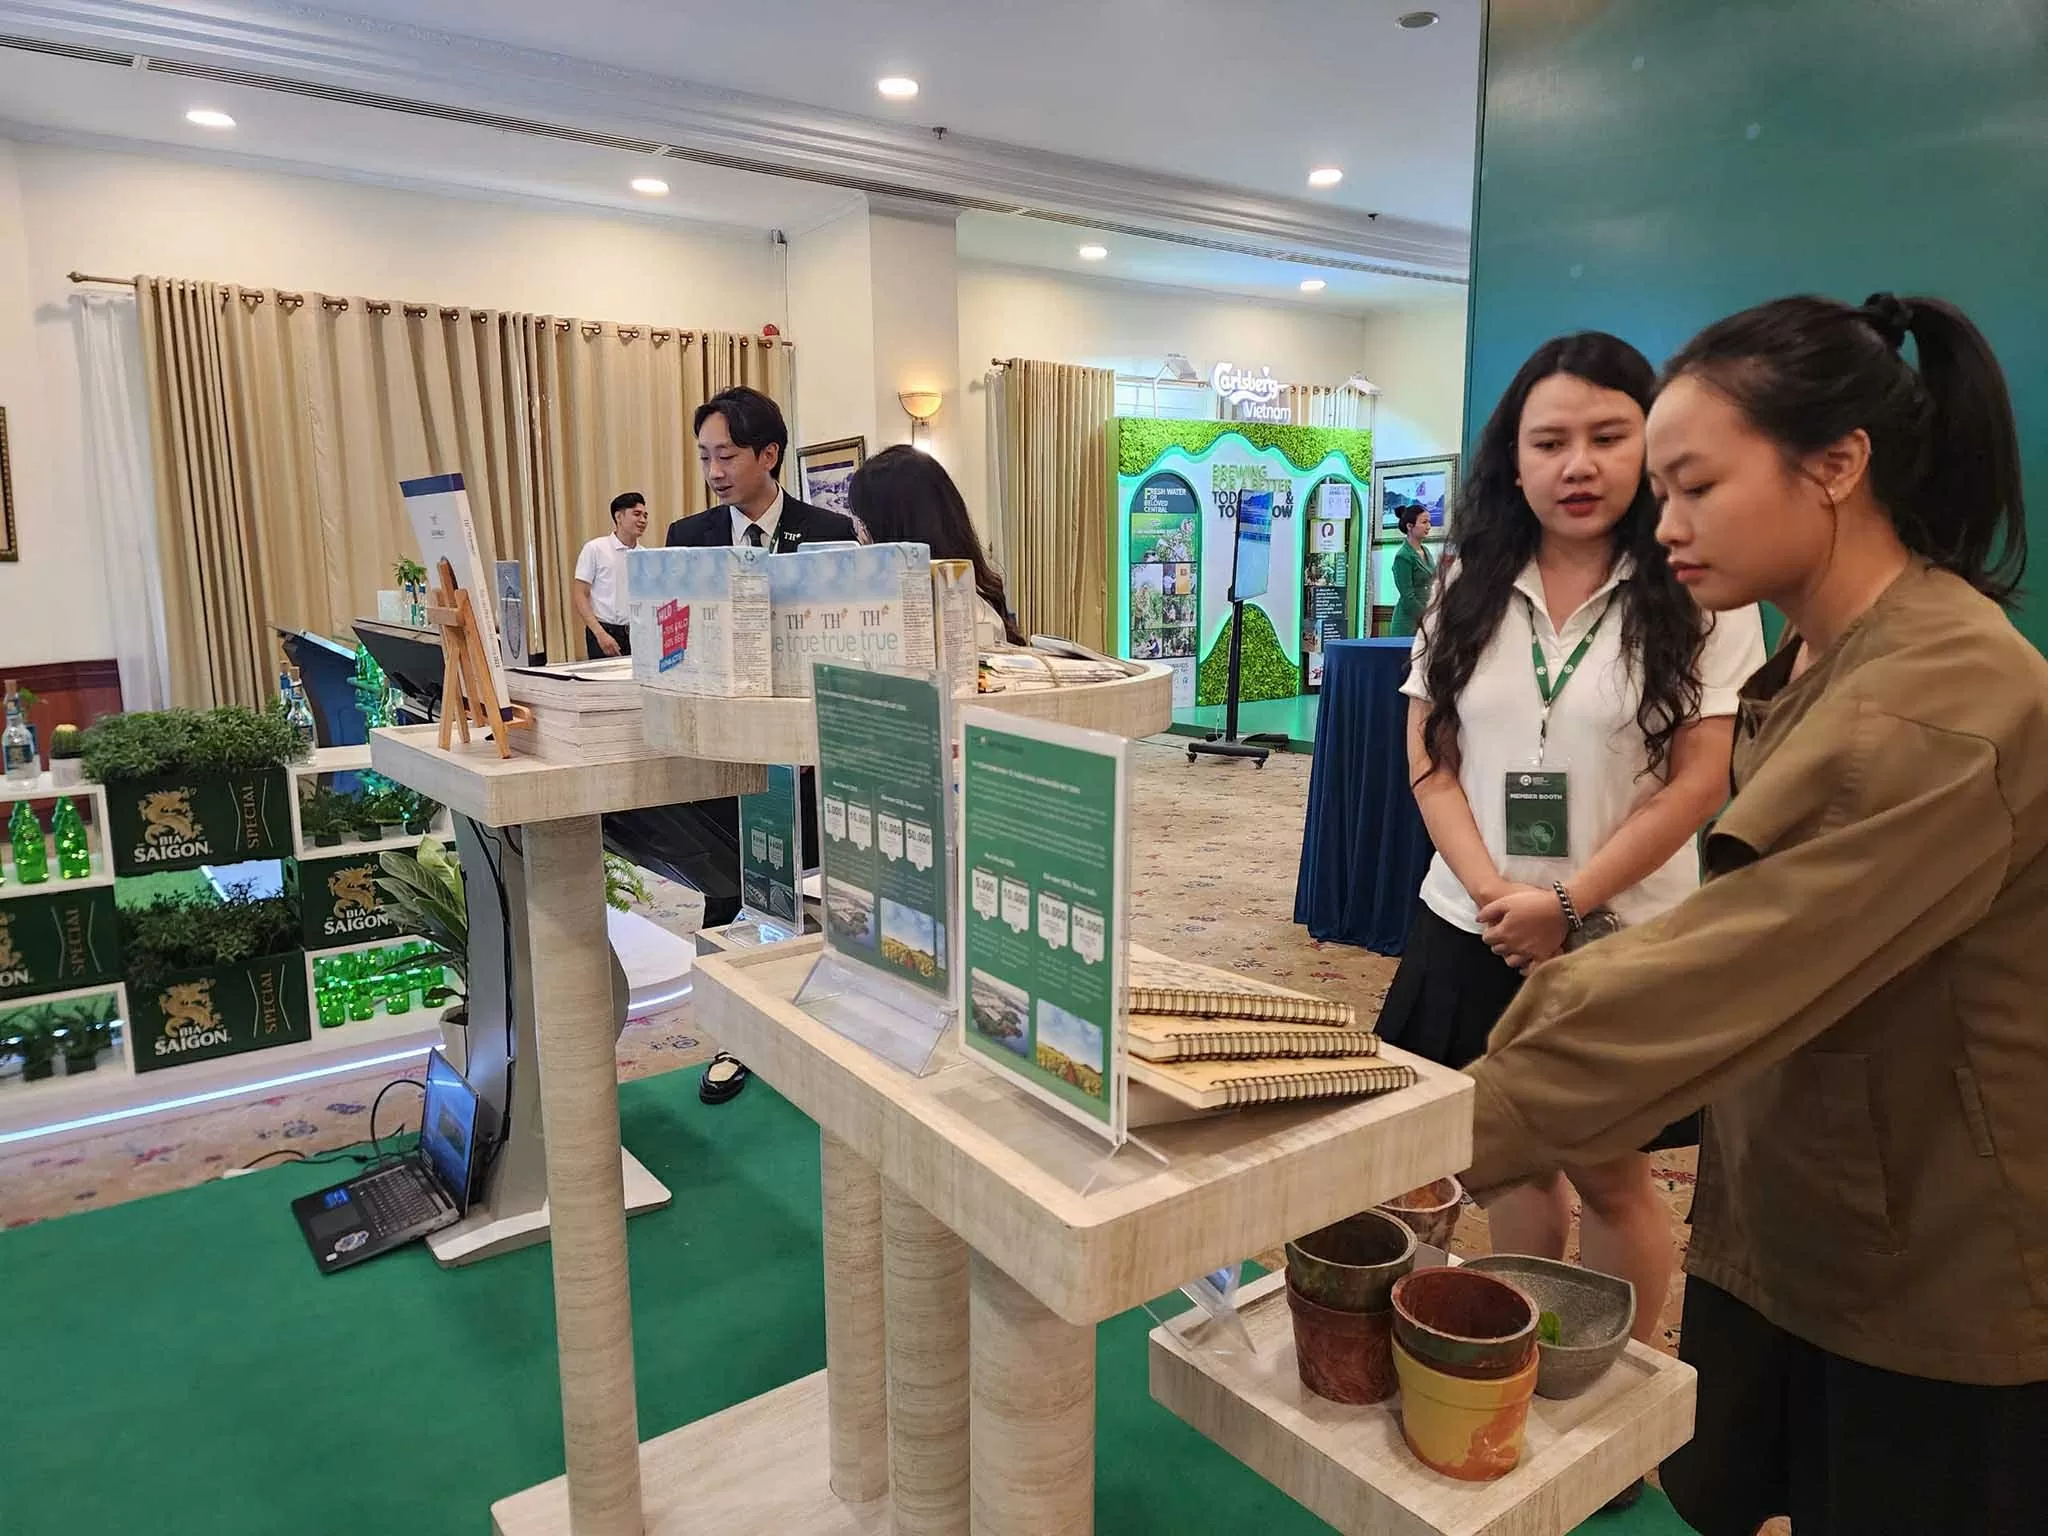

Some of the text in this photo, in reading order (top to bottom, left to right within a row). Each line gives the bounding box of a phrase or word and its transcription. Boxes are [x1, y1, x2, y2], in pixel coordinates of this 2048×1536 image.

[1211, 362, 1285, 401] Carlsberg
[1243, 400, 1291, 421] Vietnam
[1212, 464, 1267, 480] BREWING
[1251, 479, 1292, 492] BETTER
[1212, 491, 1237, 505] TOD
[785, 609, 881, 630] TH TH TH
[786, 631, 819, 653] true
[822, 631, 858, 653] true
[861, 629, 898, 651] true
[241, 782, 260, 849] SPECIAL
[159, 834, 183, 846] BIA
[134, 841, 210, 864] SAIGON
[345, 907, 367, 919] BIA
[323, 914, 389, 936] SAIGON
[260, 969, 278, 1034] SPECIAL
[154, 1028, 228, 1056] SAIGON
[179, 1025, 202, 1038] BIA
